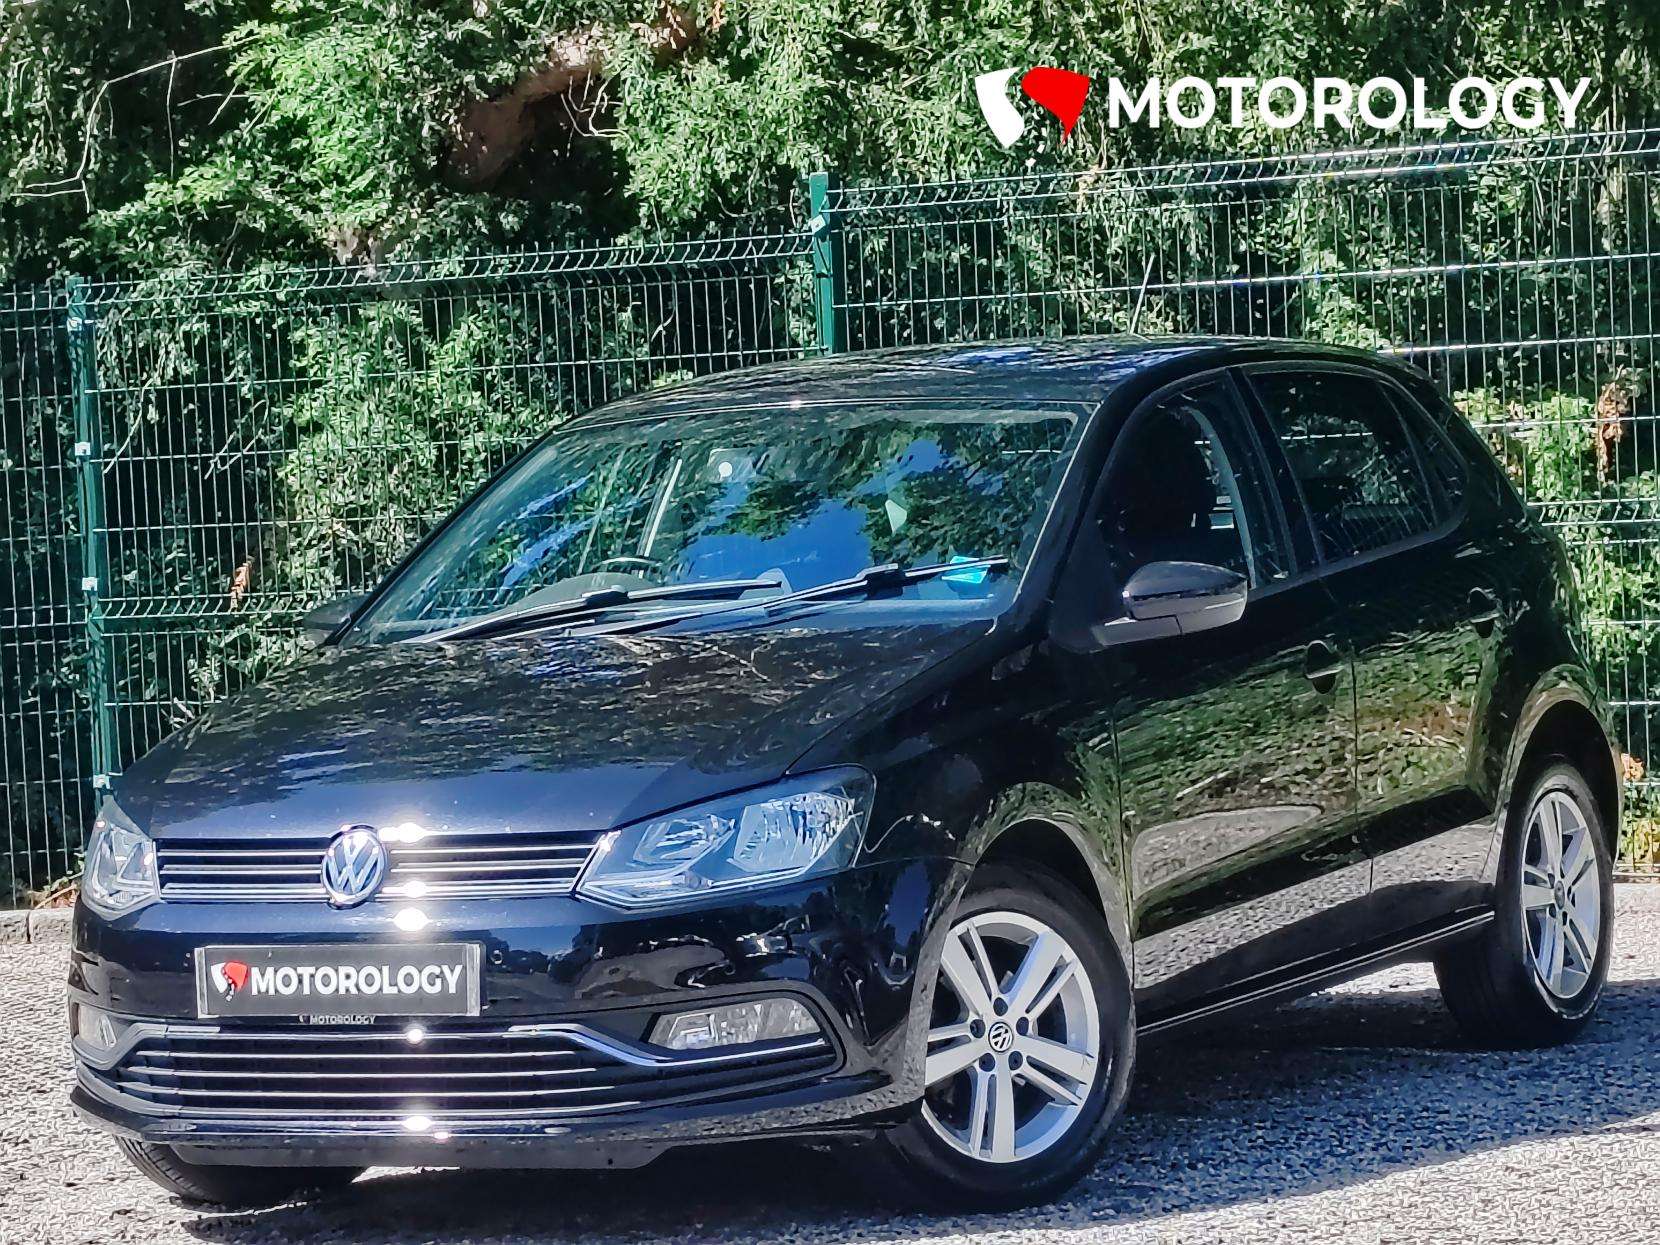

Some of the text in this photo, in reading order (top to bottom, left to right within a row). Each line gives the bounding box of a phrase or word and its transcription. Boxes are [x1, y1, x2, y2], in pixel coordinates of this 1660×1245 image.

[325, 831, 381, 895] VW
[251, 964, 463, 995] MOTOROLOGY
[309, 1014, 375, 1025] MOTOROLOGY
